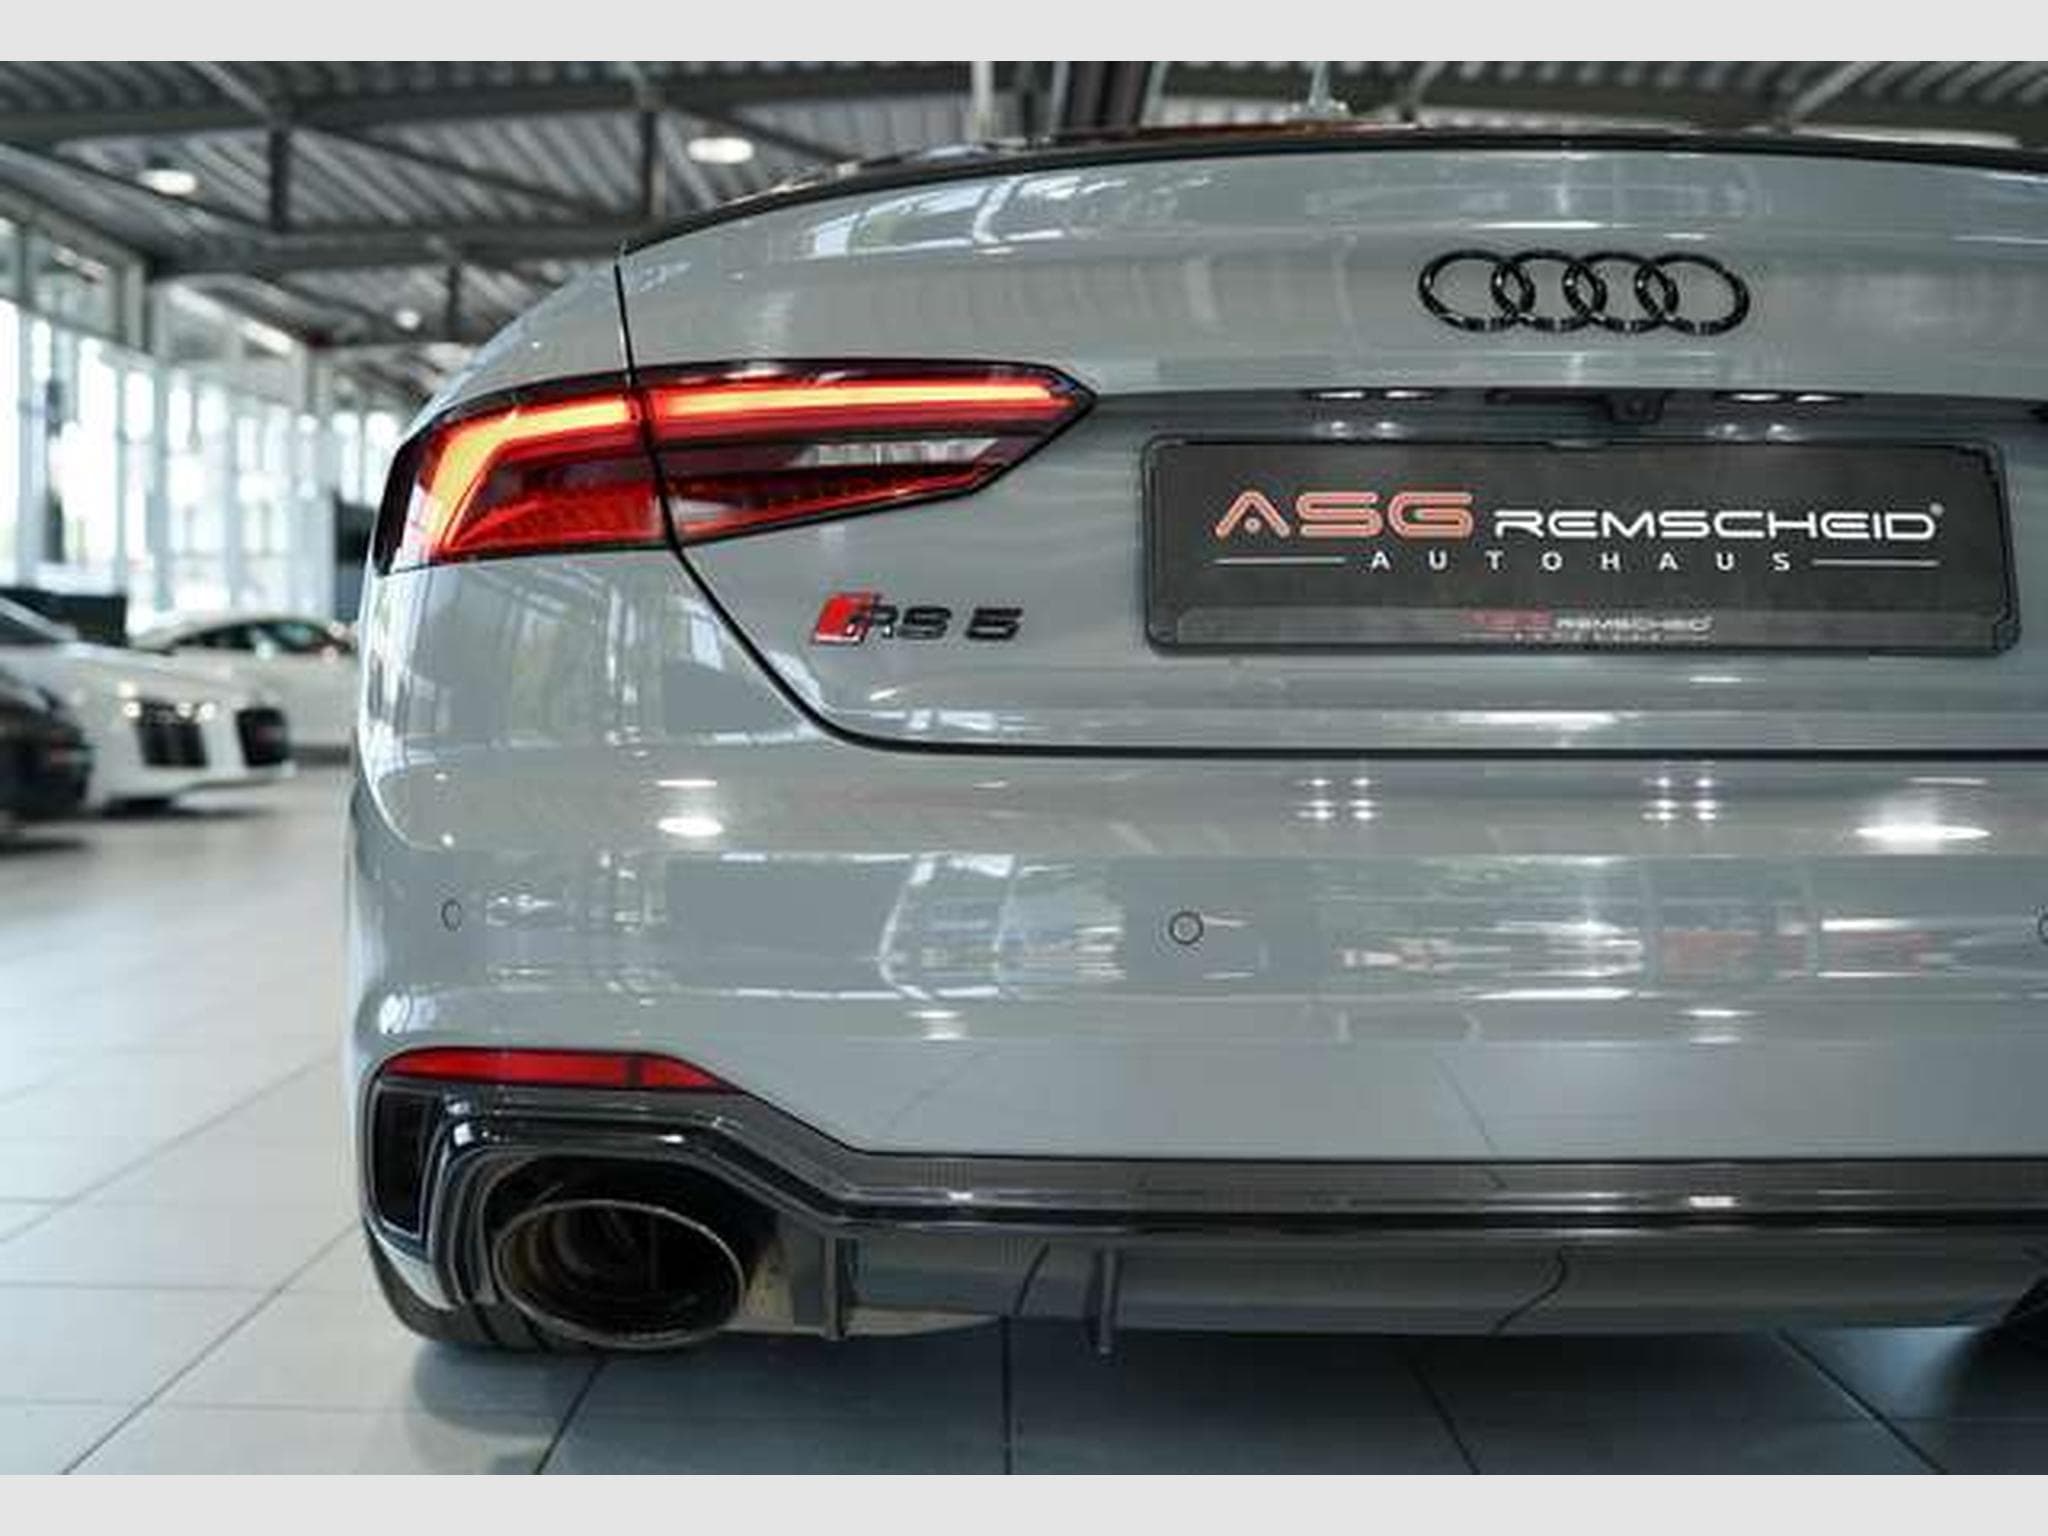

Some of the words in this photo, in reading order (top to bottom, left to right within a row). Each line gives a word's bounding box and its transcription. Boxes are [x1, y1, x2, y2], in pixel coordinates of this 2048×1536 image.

[1214, 490, 1475, 539] ASG
[1494, 509, 1936, 540] REMSCHEID
[1371, 551, 1791, 572] AUTOHAUS
[965, 606, 1023, 641] 5
